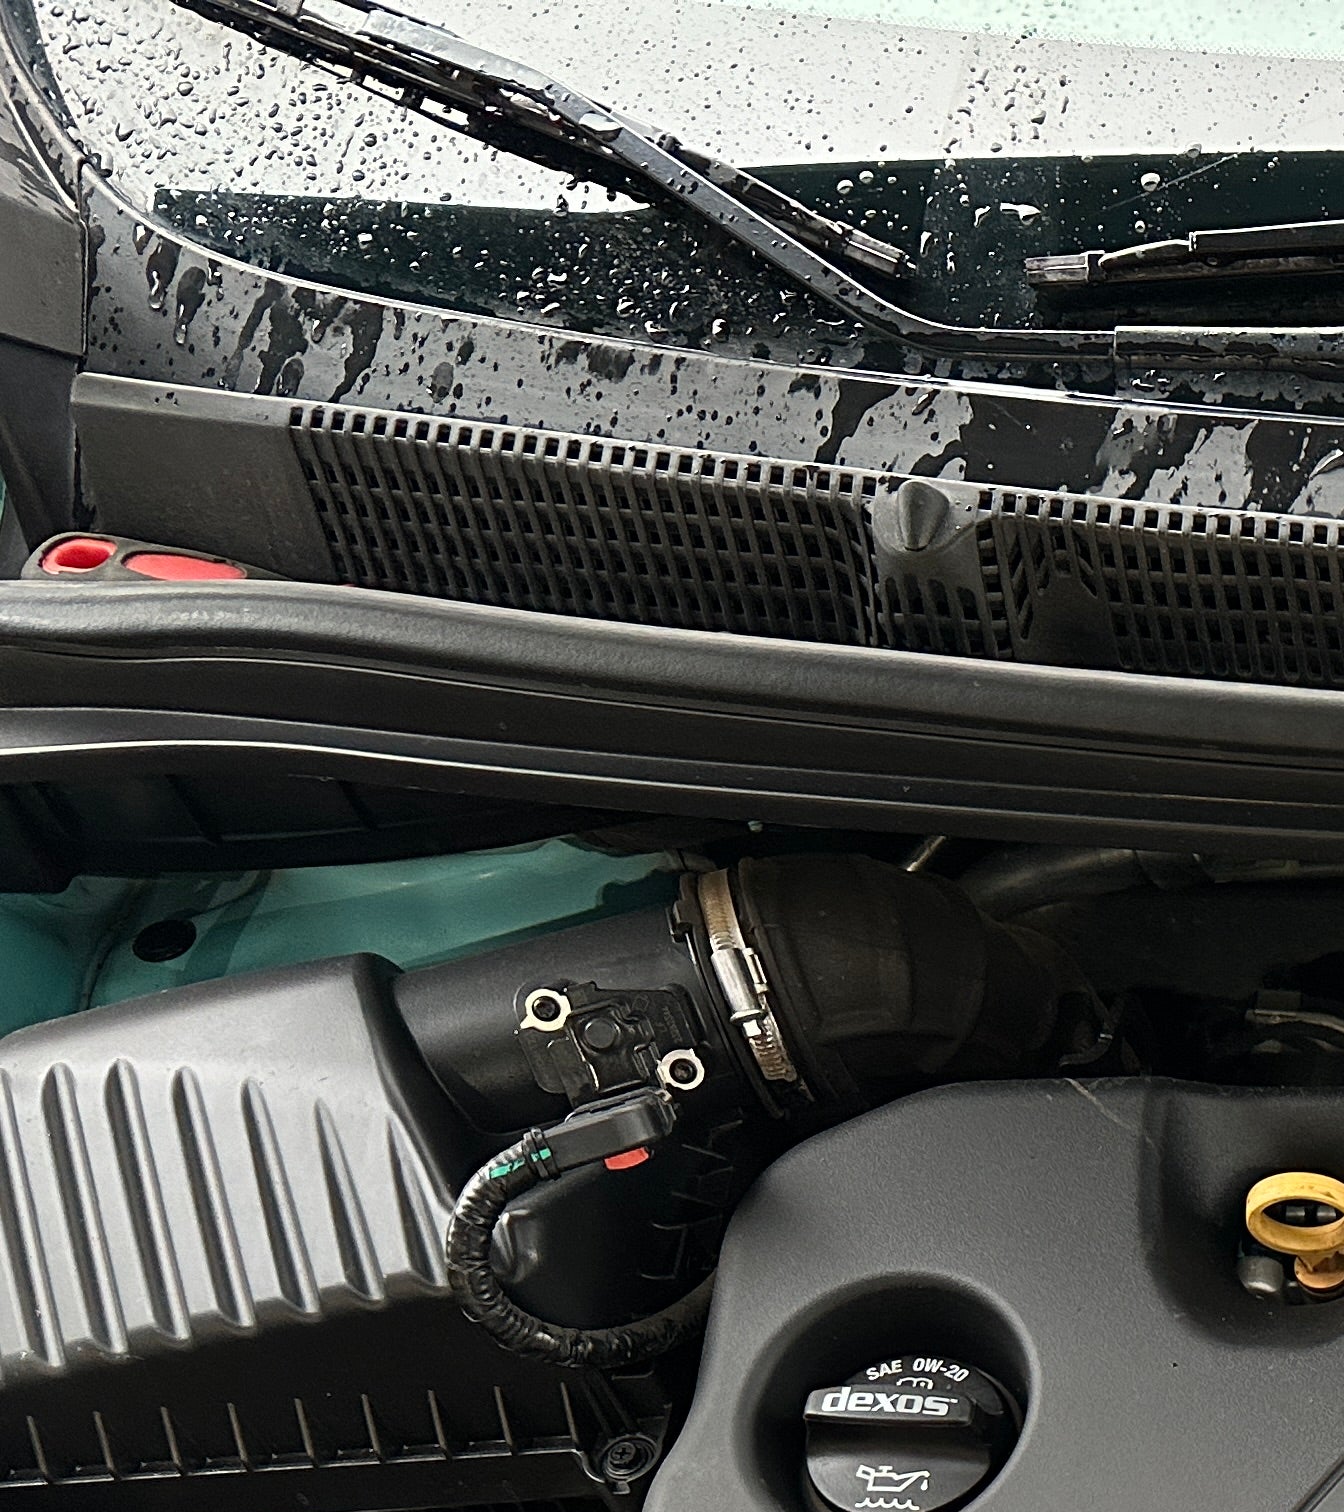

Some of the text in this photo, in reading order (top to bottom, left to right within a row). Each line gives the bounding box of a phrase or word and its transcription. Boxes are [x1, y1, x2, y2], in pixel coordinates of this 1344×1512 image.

[866, 1357, 970, 1383] SAE 0W-20
[821, 1386, 950, 1416] dexos
